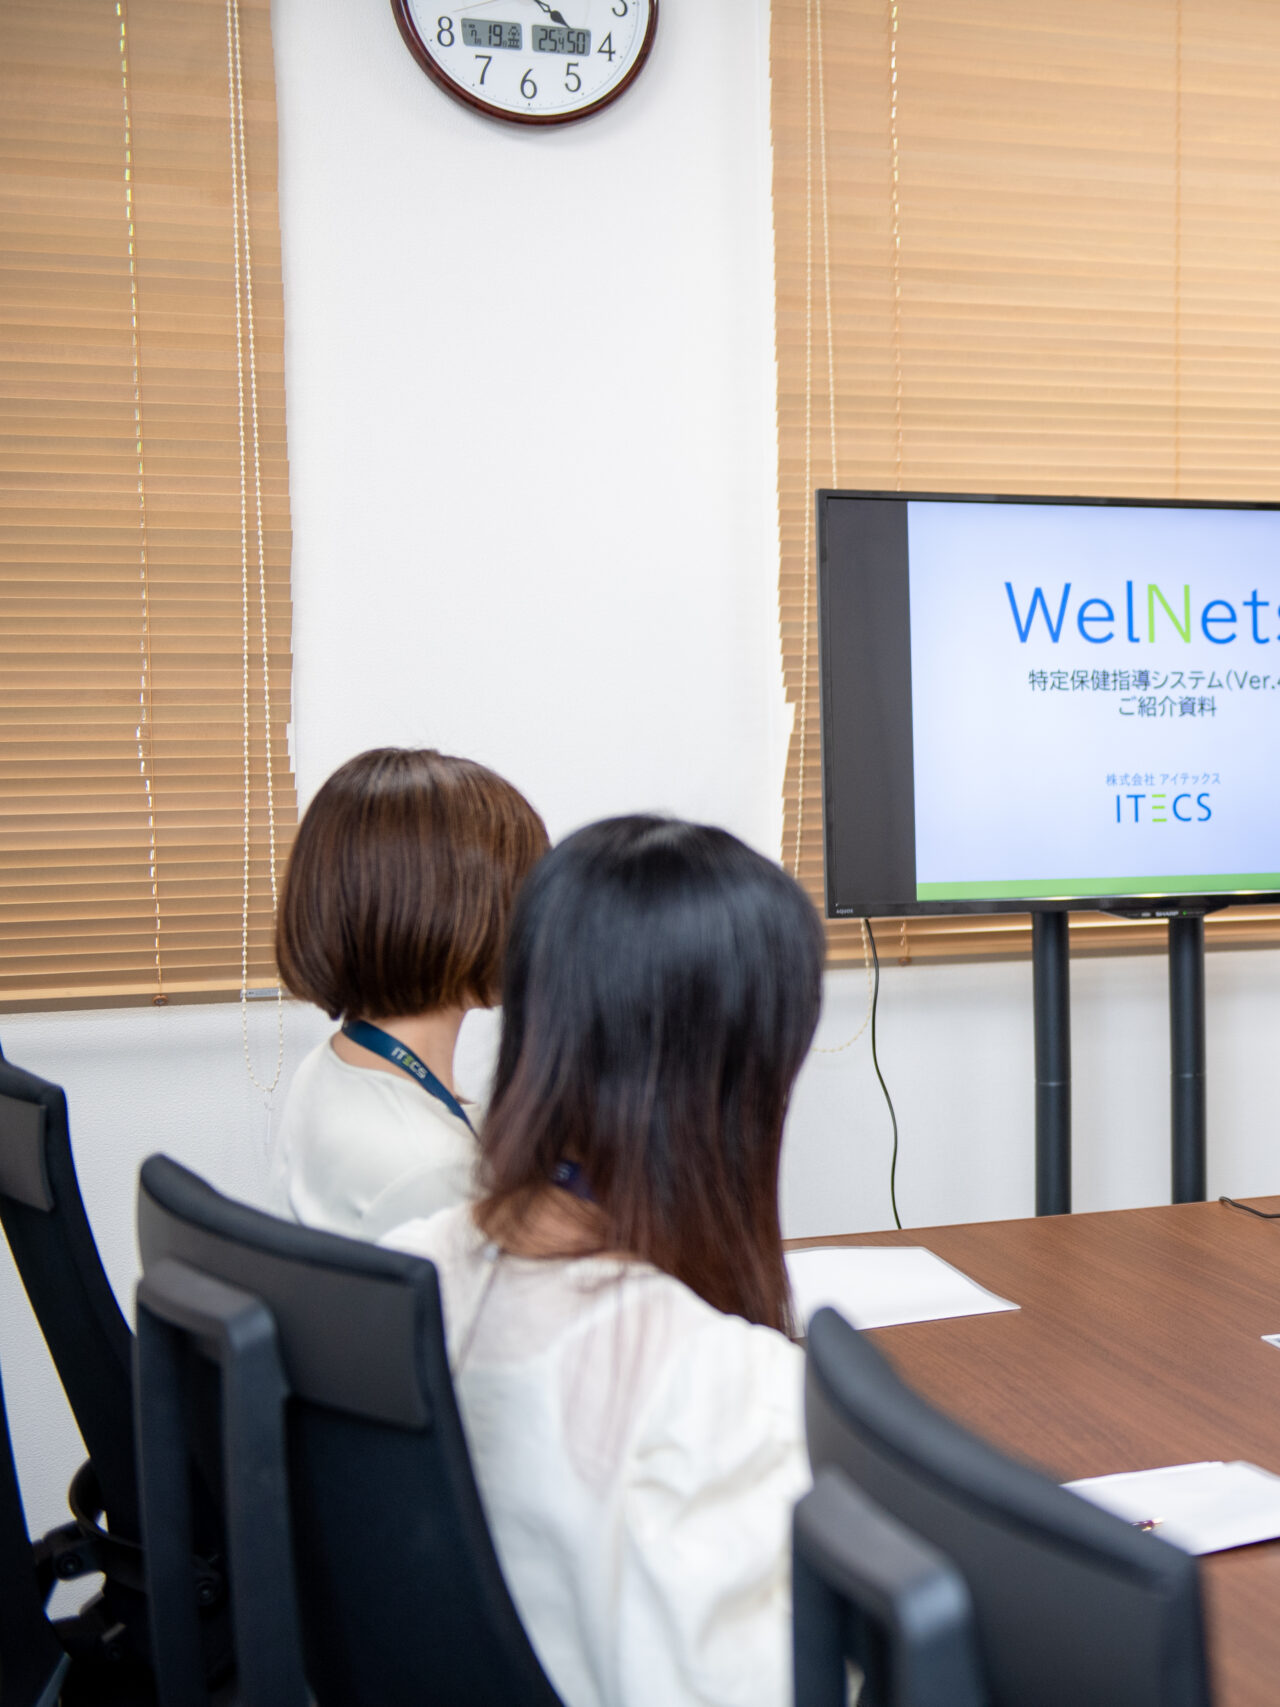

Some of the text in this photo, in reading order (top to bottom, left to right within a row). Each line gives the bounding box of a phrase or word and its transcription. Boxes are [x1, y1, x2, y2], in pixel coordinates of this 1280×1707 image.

[437, 16, 455, 47] 8
[598, 31, 616, 62] 4
[475, 54, 492, 85] 7
[520, 68, 537, 99] 6
[564, 62, 582, 92] 5
[1118, 695, 1217, 718] ご紹介資料
[1105, 772, 1221, 787] 株式会社 アイテックス
[1116, 792, 1212, 823] ITECS
[391, 1047, 428, 1080] ITECS
